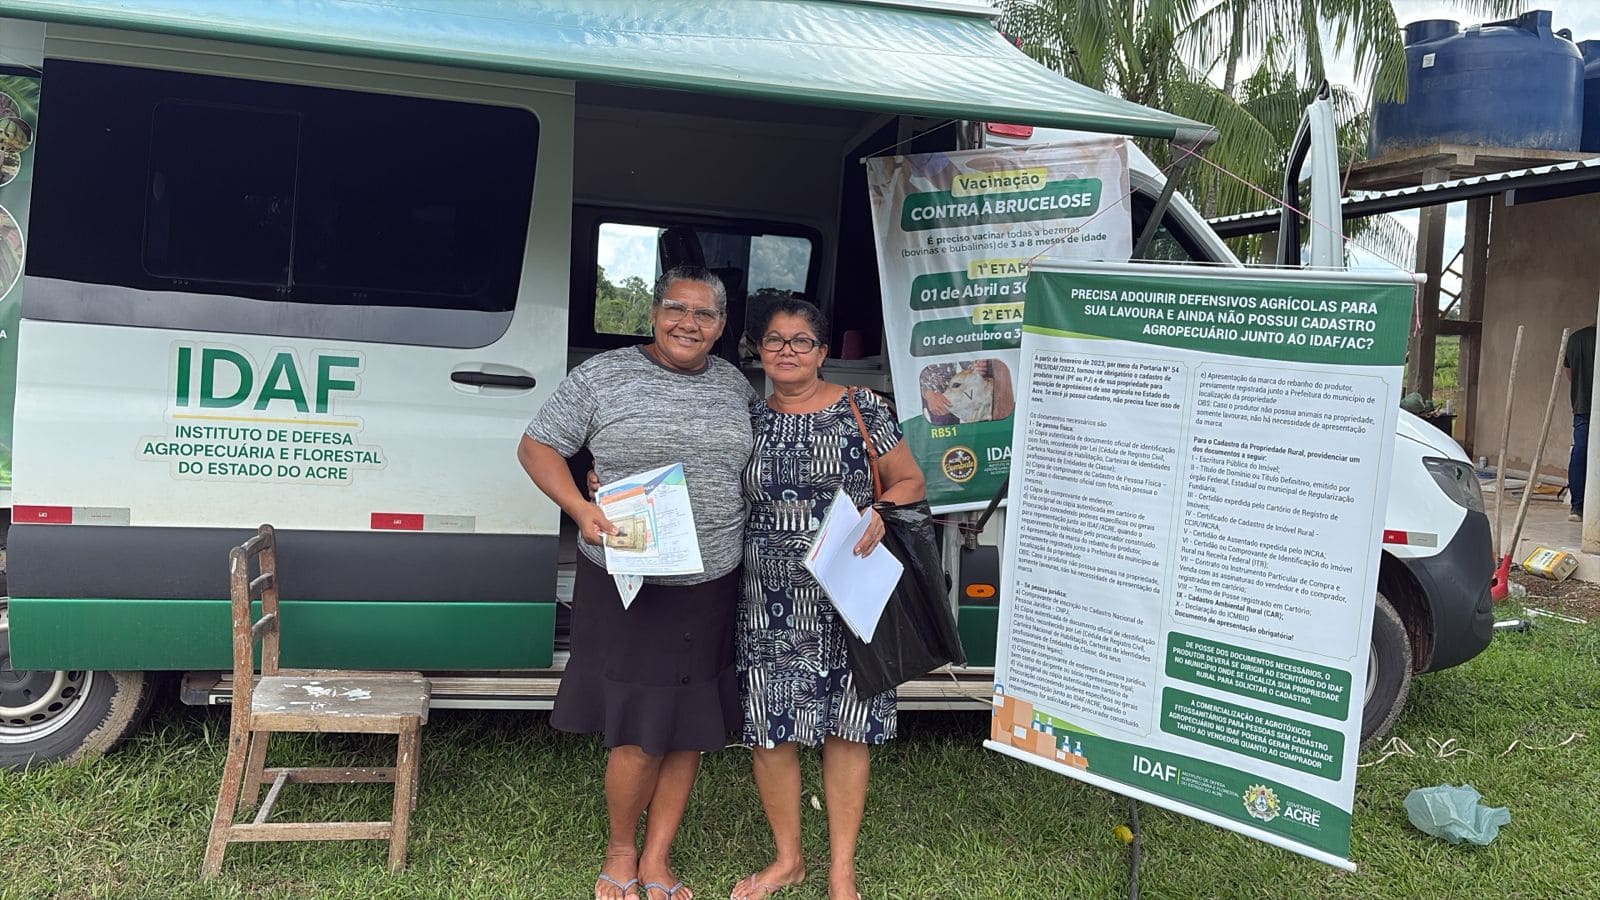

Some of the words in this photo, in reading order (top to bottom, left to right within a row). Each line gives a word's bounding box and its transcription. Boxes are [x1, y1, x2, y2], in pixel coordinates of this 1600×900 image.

[960, 173, 1040, 191] Vacinação
[911, 202, 979, 220] CONTRA
[981, 200, 992, 214] A
[995, 192, 1091, 213] BRUCELOSE
[902, 248, 939, 257] (bovinas
[950, 241, 996, 252] bubalinas)
[1081, 234, 1106, 242] idade
[927, 234, 934, 248] É
[936, 234, 970, 246] preciso
[972, 228, 1005, 240] vacinar
[1006, 226, 1032, 238] todas
[1033, 227, 1039, 236] a
[978, 263, 987, 274] 1ª
[991, 263, 1026, 274] ETAP
[921, 288, 937, 302] 01
[940, 286, 960, 300] de
[961, 282, 997, 298] Abril
[1000, 285, 1009, 295] a
[1071, 288, 1117, 300] PRECISA
[1120, 291, 1176, 304] ADQUIRIR
[1179, 294, 1256, 308] DEFENSIVOS
[1259, 298, 1337, 312] AGRÍCOLAS
[1340, 301, 1377, 314] PARA
[982, 309, 993, 320] 2ª
[996, 309, 1022, 319] ETA
[1084, 304, 1106, 315] SUA
[1110, 306, 1164, 319] LAVOURA
[1167, 309, 1174, 320] E
[1177, 310, 1214, 322] AINDA
[1218, 312, 1244, 324] NÃO
[1248, 313, 1297, 327] POSSUI
[1301, 317, 1375, 332] CADASTRO
[923, 336, 935, 346] 01
[938, 334, 953, 344] de
[956, 330, 1002, 343] outubro
[1143, 324, 1237, 340] AGROPECUÁRIO
[1241, 330, 1283, 343] JUNTO
[1288, 333, 1305, 345] AO
[1310, 334, 1373, 349] IDAF/AC?
[176, 347, 360, 413] IDAF
[1200, 370, 1206, 379] e)
[1208, 372, 1247, 382] Apresentação
[1287, 379, 1313, 388] rebanho
[175, 425, 262, 441] INSTITUTO
[267, 429, 287, 442] DE
[292, 430, 352, 445] DEFESA
[932, 427, 957, 438] RB51
[143, 442, 275, 459] AGROPECUÁRIA
[280, 447, 289, 459] E
[294, 448, 381, 463] FLORESTAL
[987, 446, 1012, 461] IDA
[1213, 438, 1239, 448] Cadastro
[1249, 443, 1286, 453] Propriedade
[1287, 448, 1305, 457] Rural,
[1307, 451, 1348, 461] providenciar
[179, 461, 202, 474] DO
[209, 462, 272, 476] ESTADO
[278, 465, 300, 477] DO
[306, 466, 346, 479] ACRE
[1188, 593, 1213, 604] Cadastro
[1215, 599, 1245, 611] Ambiental
[1246, 606, 1262, 614] Rural
[1194, 643, 1214, 653] POSSE
[1216, 648, 1228, 656] DOS
[1230, 651, 1274, 667] DOCUMENTOS
[1172, 646, 1205, 660] PRODUTOR
[1206, 654, 1230, 666] DEVERÁ
[1240, 663, 1263, 674] DIRIGIR
[1275, 671, 1315, 686] ESCRITÓRIO
[1316, 680, 1326, 689] DO
[1327, 683, 1343, 692] IDAF
[1184, 658, 1216, 672] MUNICÍPIO
[1217, 666, 1235, 676] ONDE
[1245, 673, 1276, 686] LOCALIZA
[1277, 681, 1291, 690] SUA
[1292, 684, 1339, 702] PROPRIEDADE
[1196, 670, 1215, 681] RURAL
[1217, 675, 1233, 685] PARA
[1235, 680, 1267, 694] SOLICITAR
[1174, 704, 1227, 723] FITOSSANITÁRIOS
[1228, 718, 1244, 728] PARA
[1245, 723, 1275, 736] PESSOAS
[1276, 731, 1291, 741] SEM
[1292, 735, 1328, 751] CADASTRO
[1196, 701, 1253, 721] COMERCIALIZAÇÃO
[1255, 716, 1263, 724] DE
[1264, 719, 1311, 737] AGROTÓXICOS
[1168, 711, 1214, 729] AGROPECUÁRIO
[1226, 727, 1240, 736] IDAF
[1241, 731, 1267, 744] PODERÁ
[1268, 738, 1290, 750] GERAR
[1291, 744, 1333, 762] PENALIDADE
[1177, 722, 1196, 732] TANTO
[1206, 730, 1239, 745] VENDEDOR
[1240, 740, 1267, 753] QUANTO
[1268, 748, 1278, 756] AO
[1279, 751, 1321, 768] COMPRADOR
[1132, 755, 1177, 782] IDAF
[1284, 807, 1320, 827] ACRE
